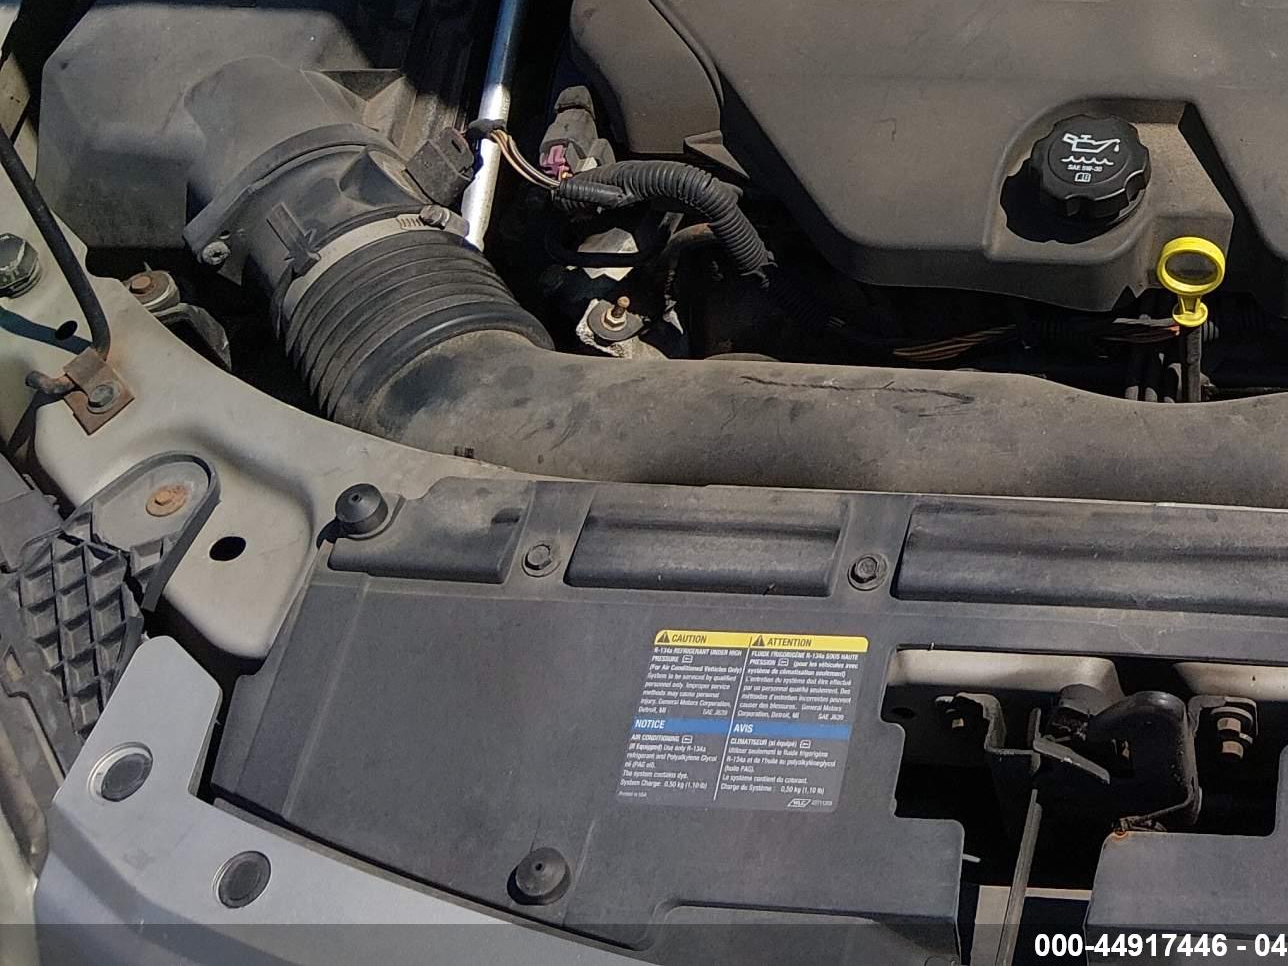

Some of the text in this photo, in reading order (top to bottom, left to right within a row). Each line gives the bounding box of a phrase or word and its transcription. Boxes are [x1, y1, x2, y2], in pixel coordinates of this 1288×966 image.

[670, 634, 706, 643] CAUTION
[767, 637, 812, 646] ATTENTION
[634, 719, 666, 728] NOTICE
[733, 723, 753, 732] AVIS
